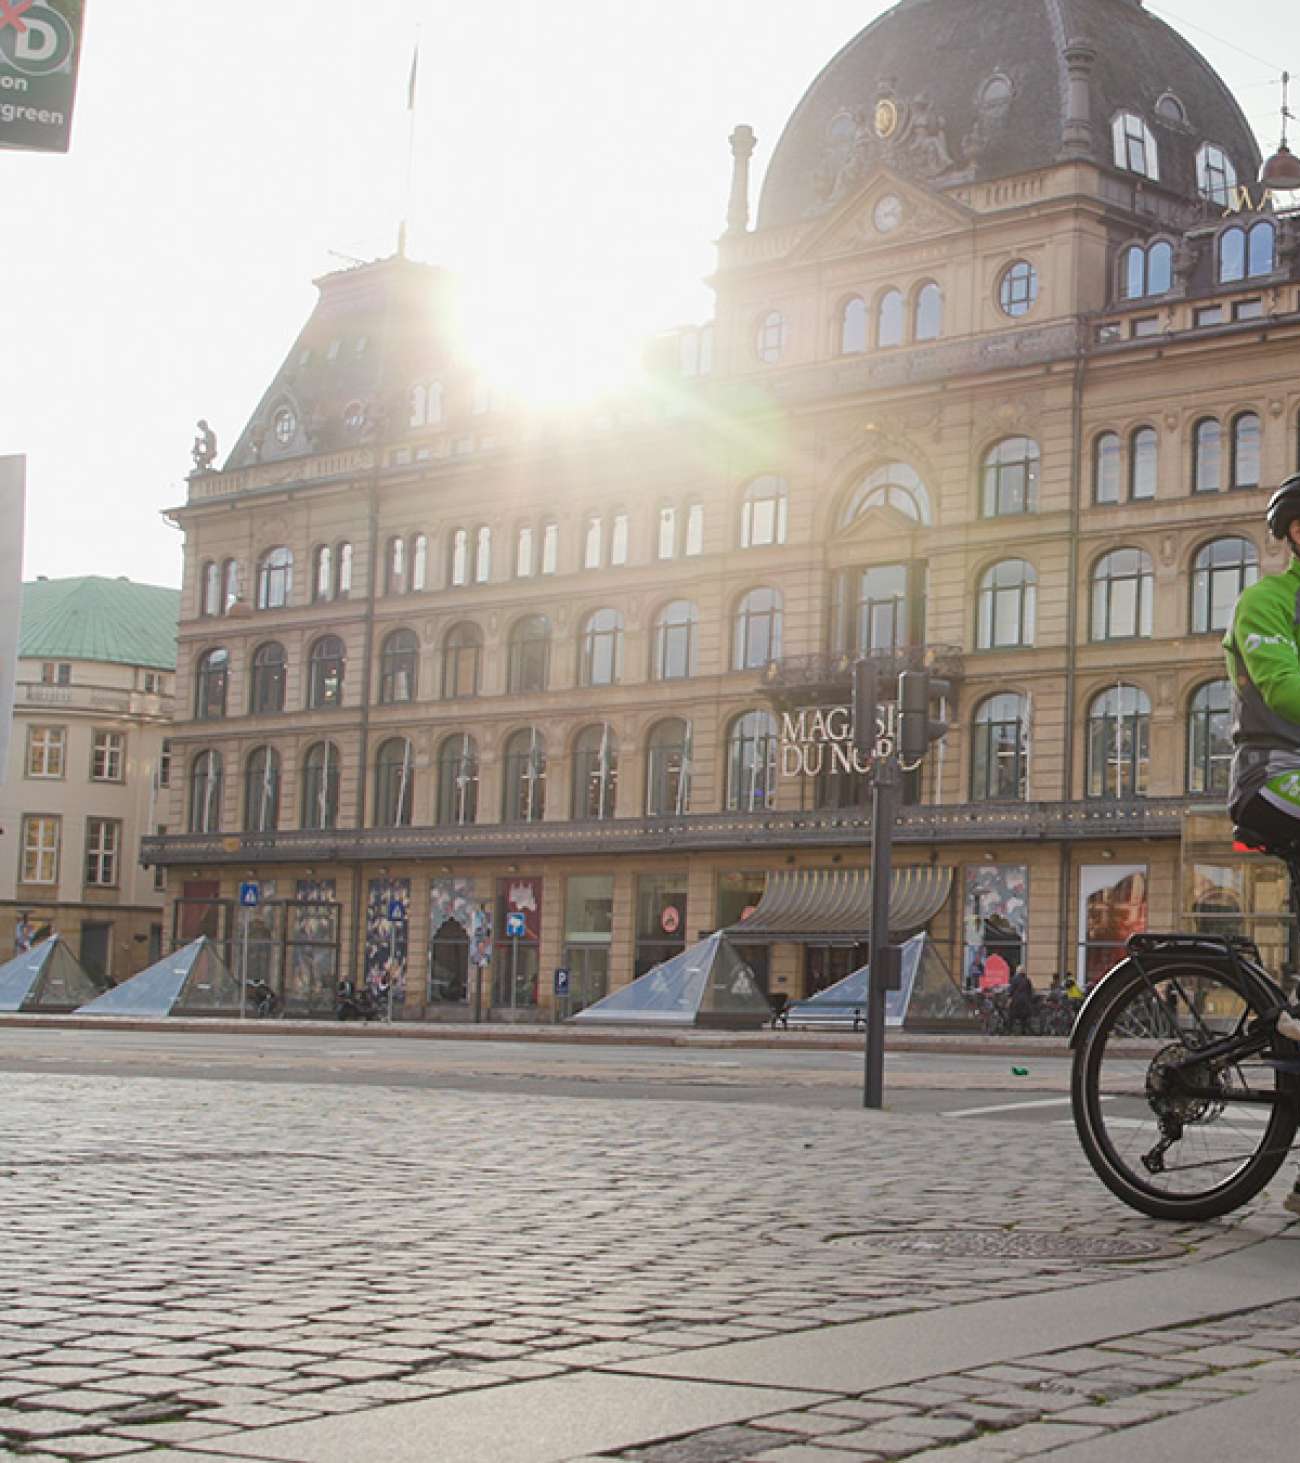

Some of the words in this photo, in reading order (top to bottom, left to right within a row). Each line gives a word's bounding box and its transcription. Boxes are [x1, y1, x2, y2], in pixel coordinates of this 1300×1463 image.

[0, 75, 28, 91] on
[0, 103, 64, 125] green
[782, 744, 824, 776] DU
